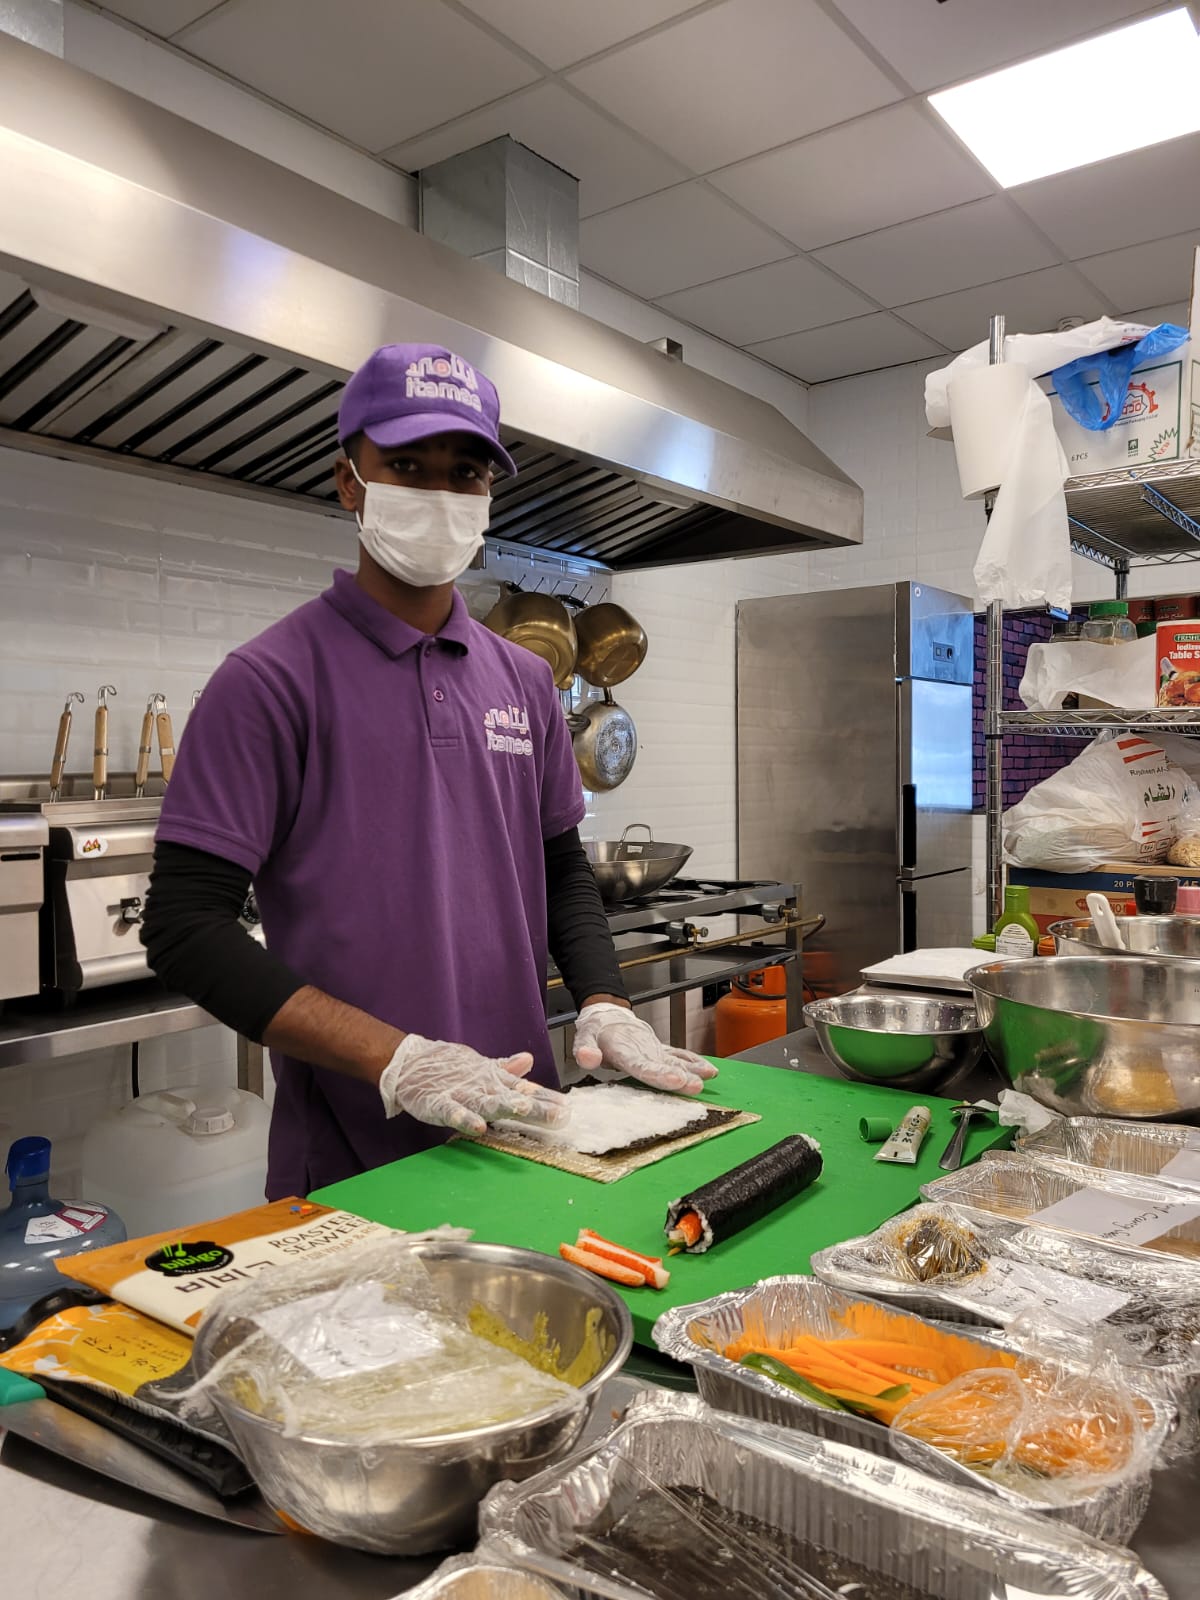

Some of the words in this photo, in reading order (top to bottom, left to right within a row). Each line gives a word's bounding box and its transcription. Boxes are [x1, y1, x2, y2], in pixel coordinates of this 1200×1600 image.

[1168, 650, 1193, 660] Table
[1114, 880, 1124, 888] 20
[268, 1213, 358, 1249] ROASTED
[160, 1249, 223, 1270] bibigo
